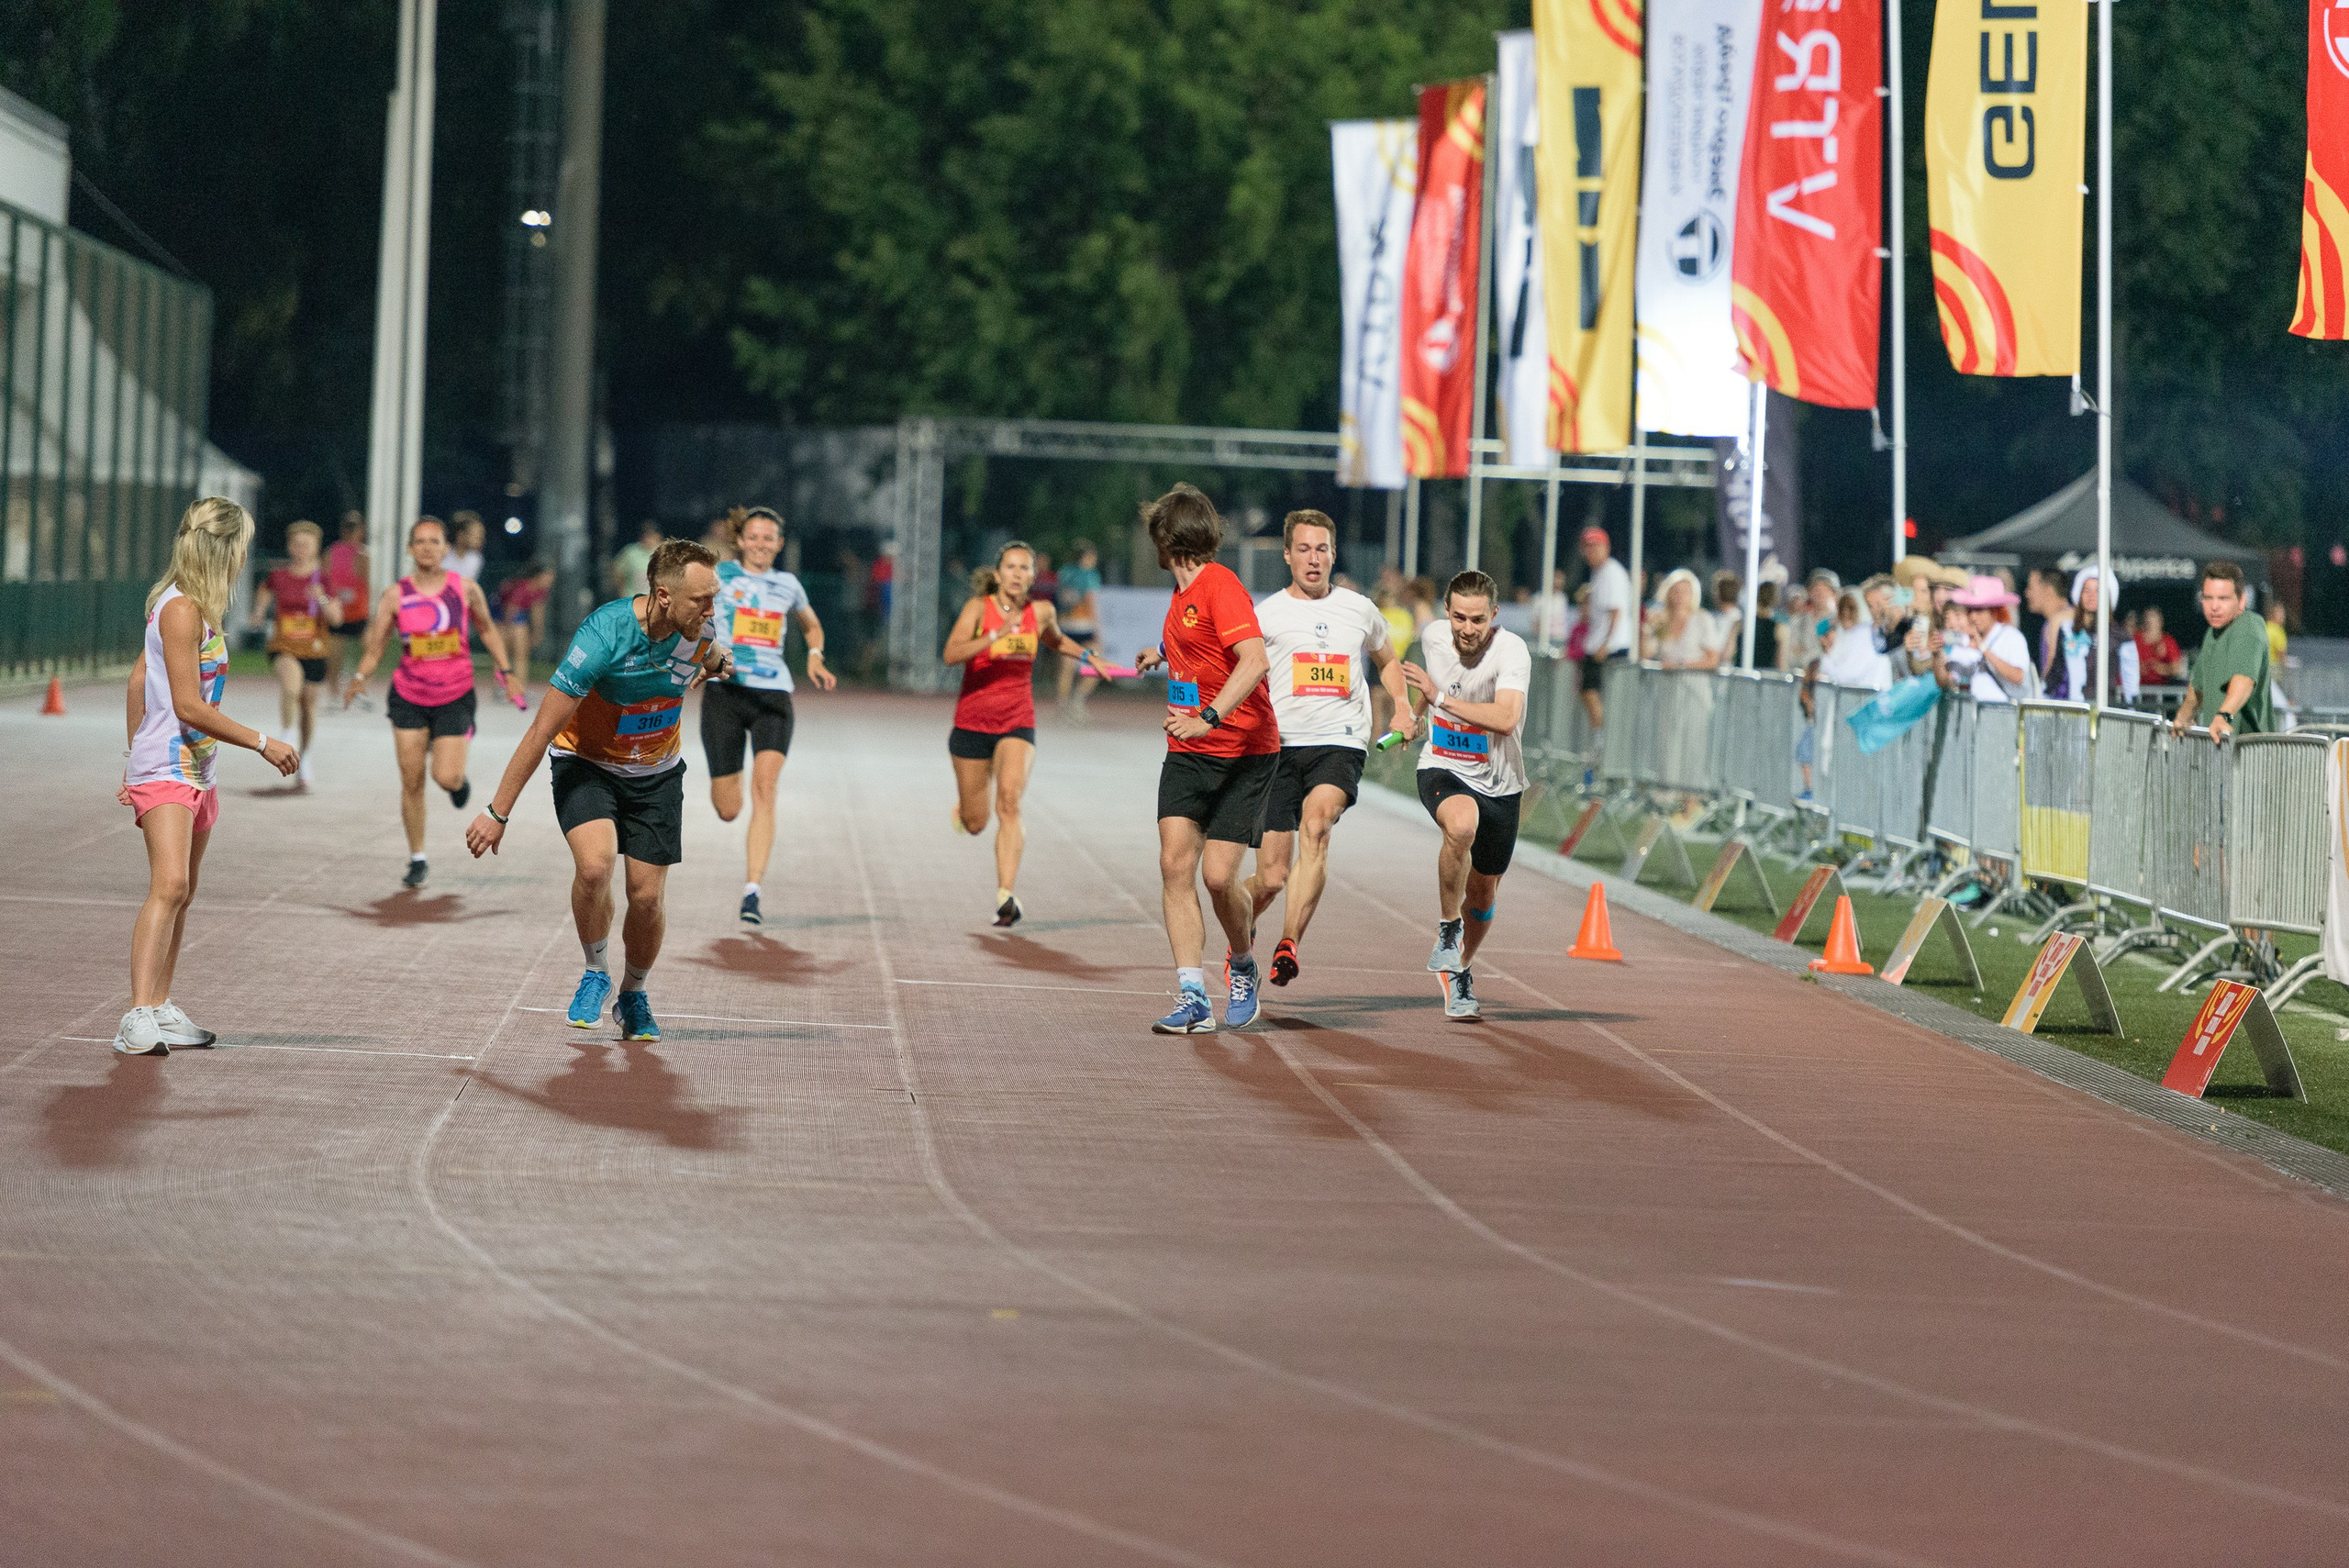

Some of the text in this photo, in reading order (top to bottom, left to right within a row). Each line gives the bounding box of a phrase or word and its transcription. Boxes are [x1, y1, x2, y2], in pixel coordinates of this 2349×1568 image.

[1310, 667, 1345, 683] 314 2
[1172, 684, 1195, 702] 315 3
[637, 714, 663, 730] 316
[1447, 734, 1470, 749] 314
